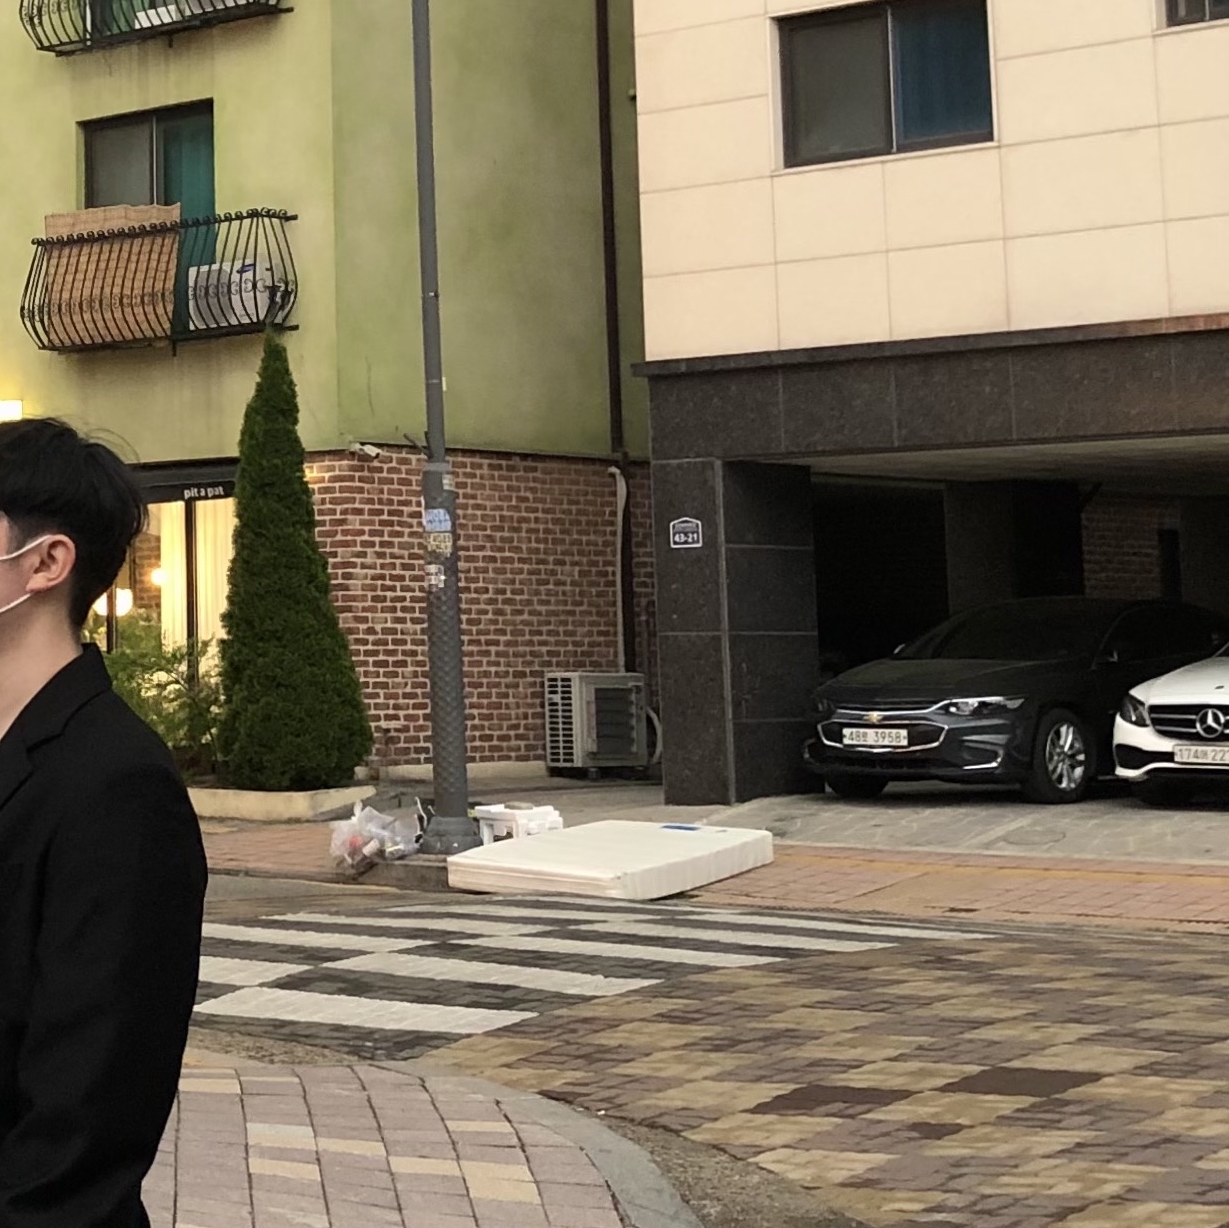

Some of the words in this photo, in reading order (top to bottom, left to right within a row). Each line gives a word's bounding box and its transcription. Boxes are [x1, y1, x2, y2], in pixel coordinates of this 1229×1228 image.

[184, 487, 199, 500] pit
[200, 488, 206, 497] a
[207, 486, 225, 498] pat
[674, 533, 698, 543] 43-21
[872, 731, 902, 744] 3958
